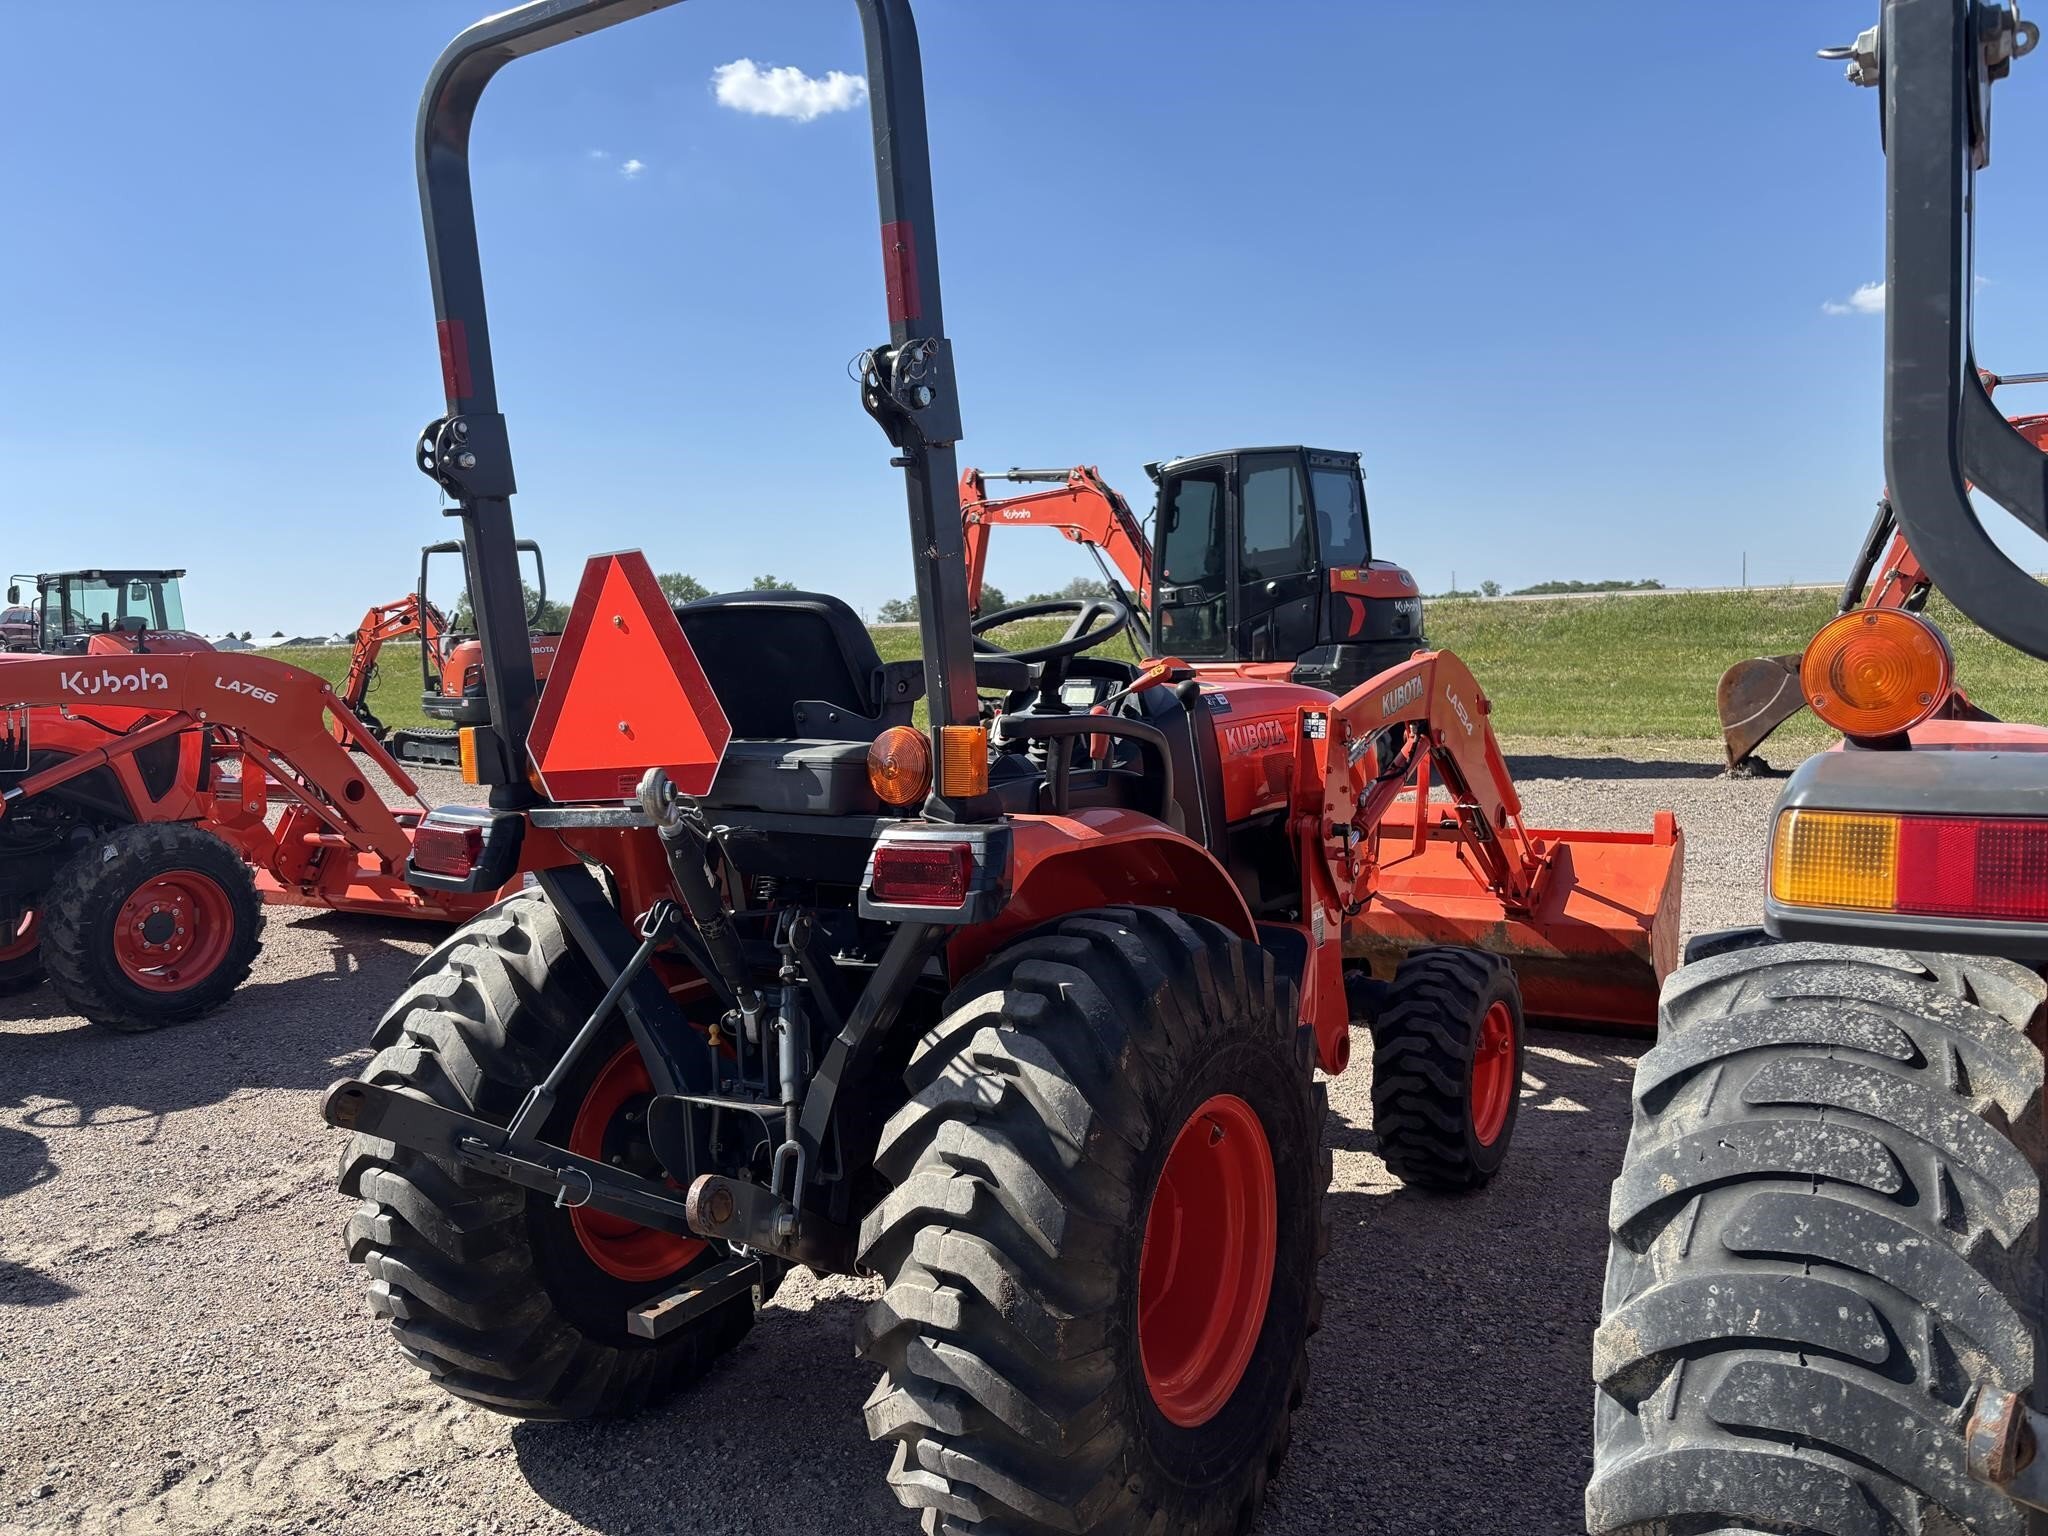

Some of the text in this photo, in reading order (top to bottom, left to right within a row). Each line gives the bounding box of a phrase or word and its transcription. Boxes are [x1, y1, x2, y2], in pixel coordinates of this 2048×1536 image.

[1003, 508, 1031, 520] Kubota
[60, 667, 169, 695] Kubota
[214, 676, 279, 704] LA766
[1382, 675, 1424, 718] KUBOTA
[1446, 684, 1473, 736] LA534
[1225, 719, 1287, 755] KUBOTA
